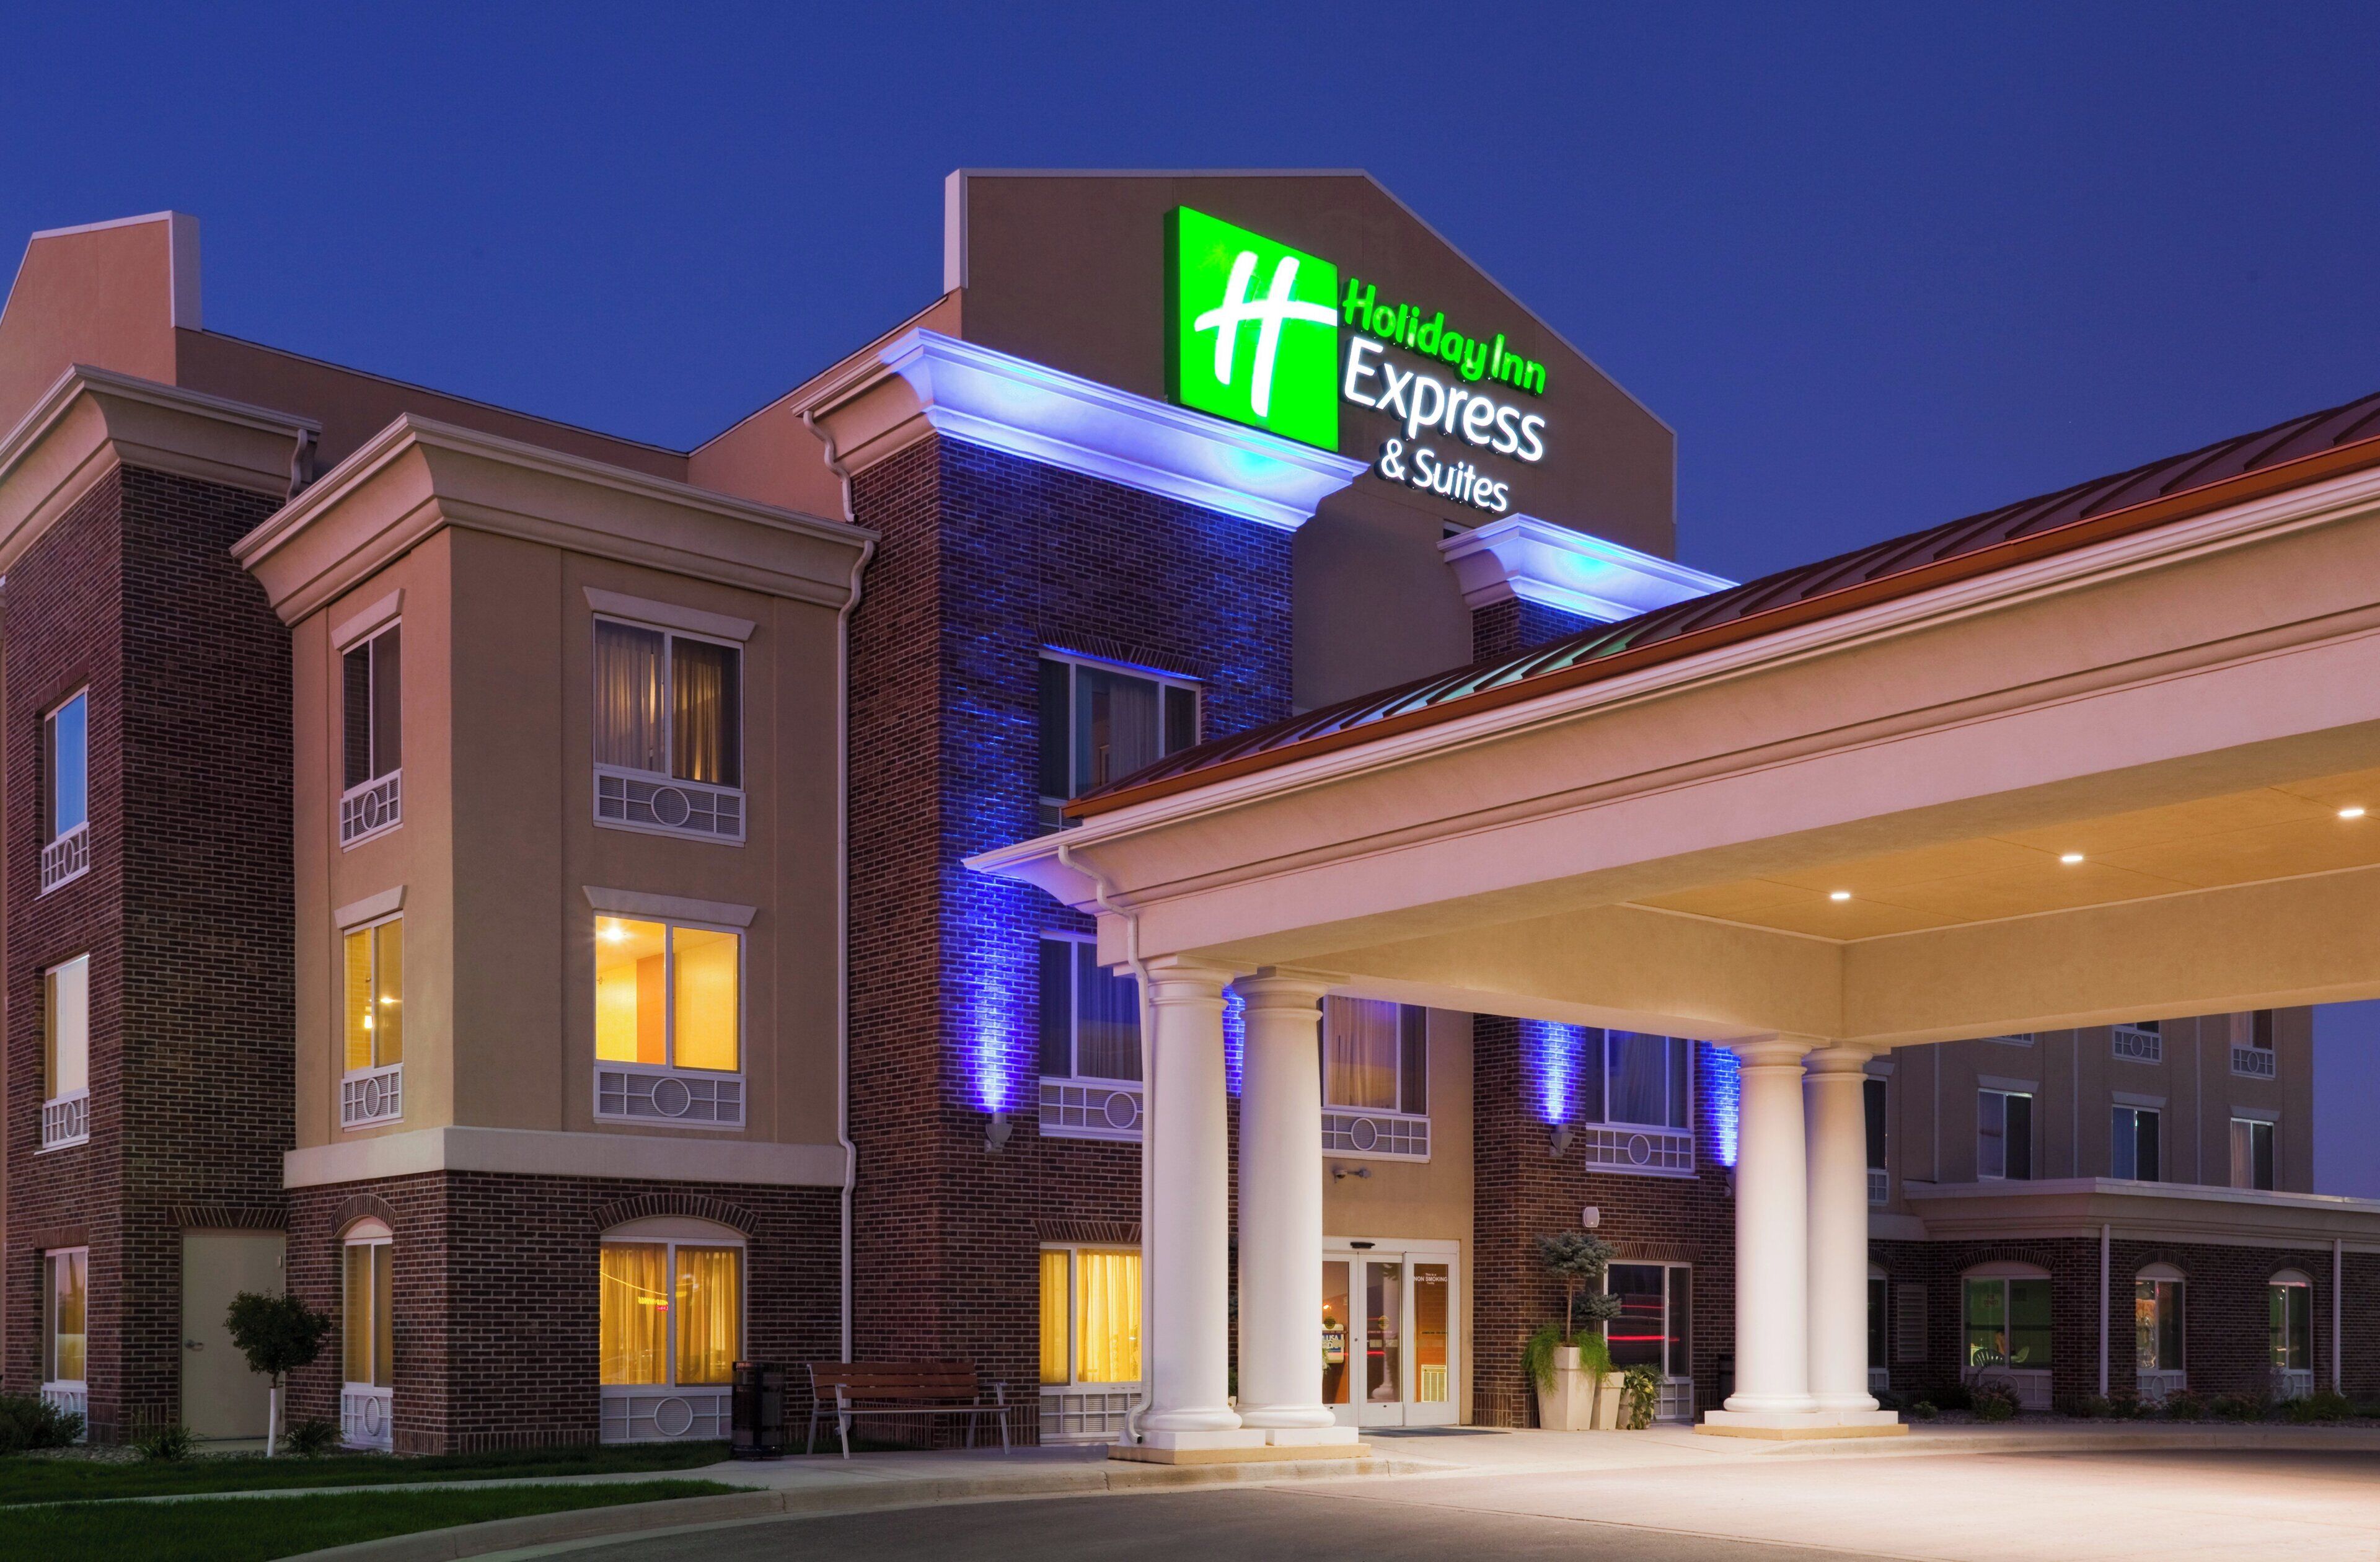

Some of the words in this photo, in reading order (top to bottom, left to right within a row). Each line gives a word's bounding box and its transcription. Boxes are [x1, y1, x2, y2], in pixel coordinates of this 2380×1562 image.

[1342, 278, 1486, 382] Holiday
[1489, 333, 1546, 394] Inn
[1344, 337, 1546, 462] Express
[1380, 438, 1405, 480] &
[1413, 449, 1509, 513] Suites
